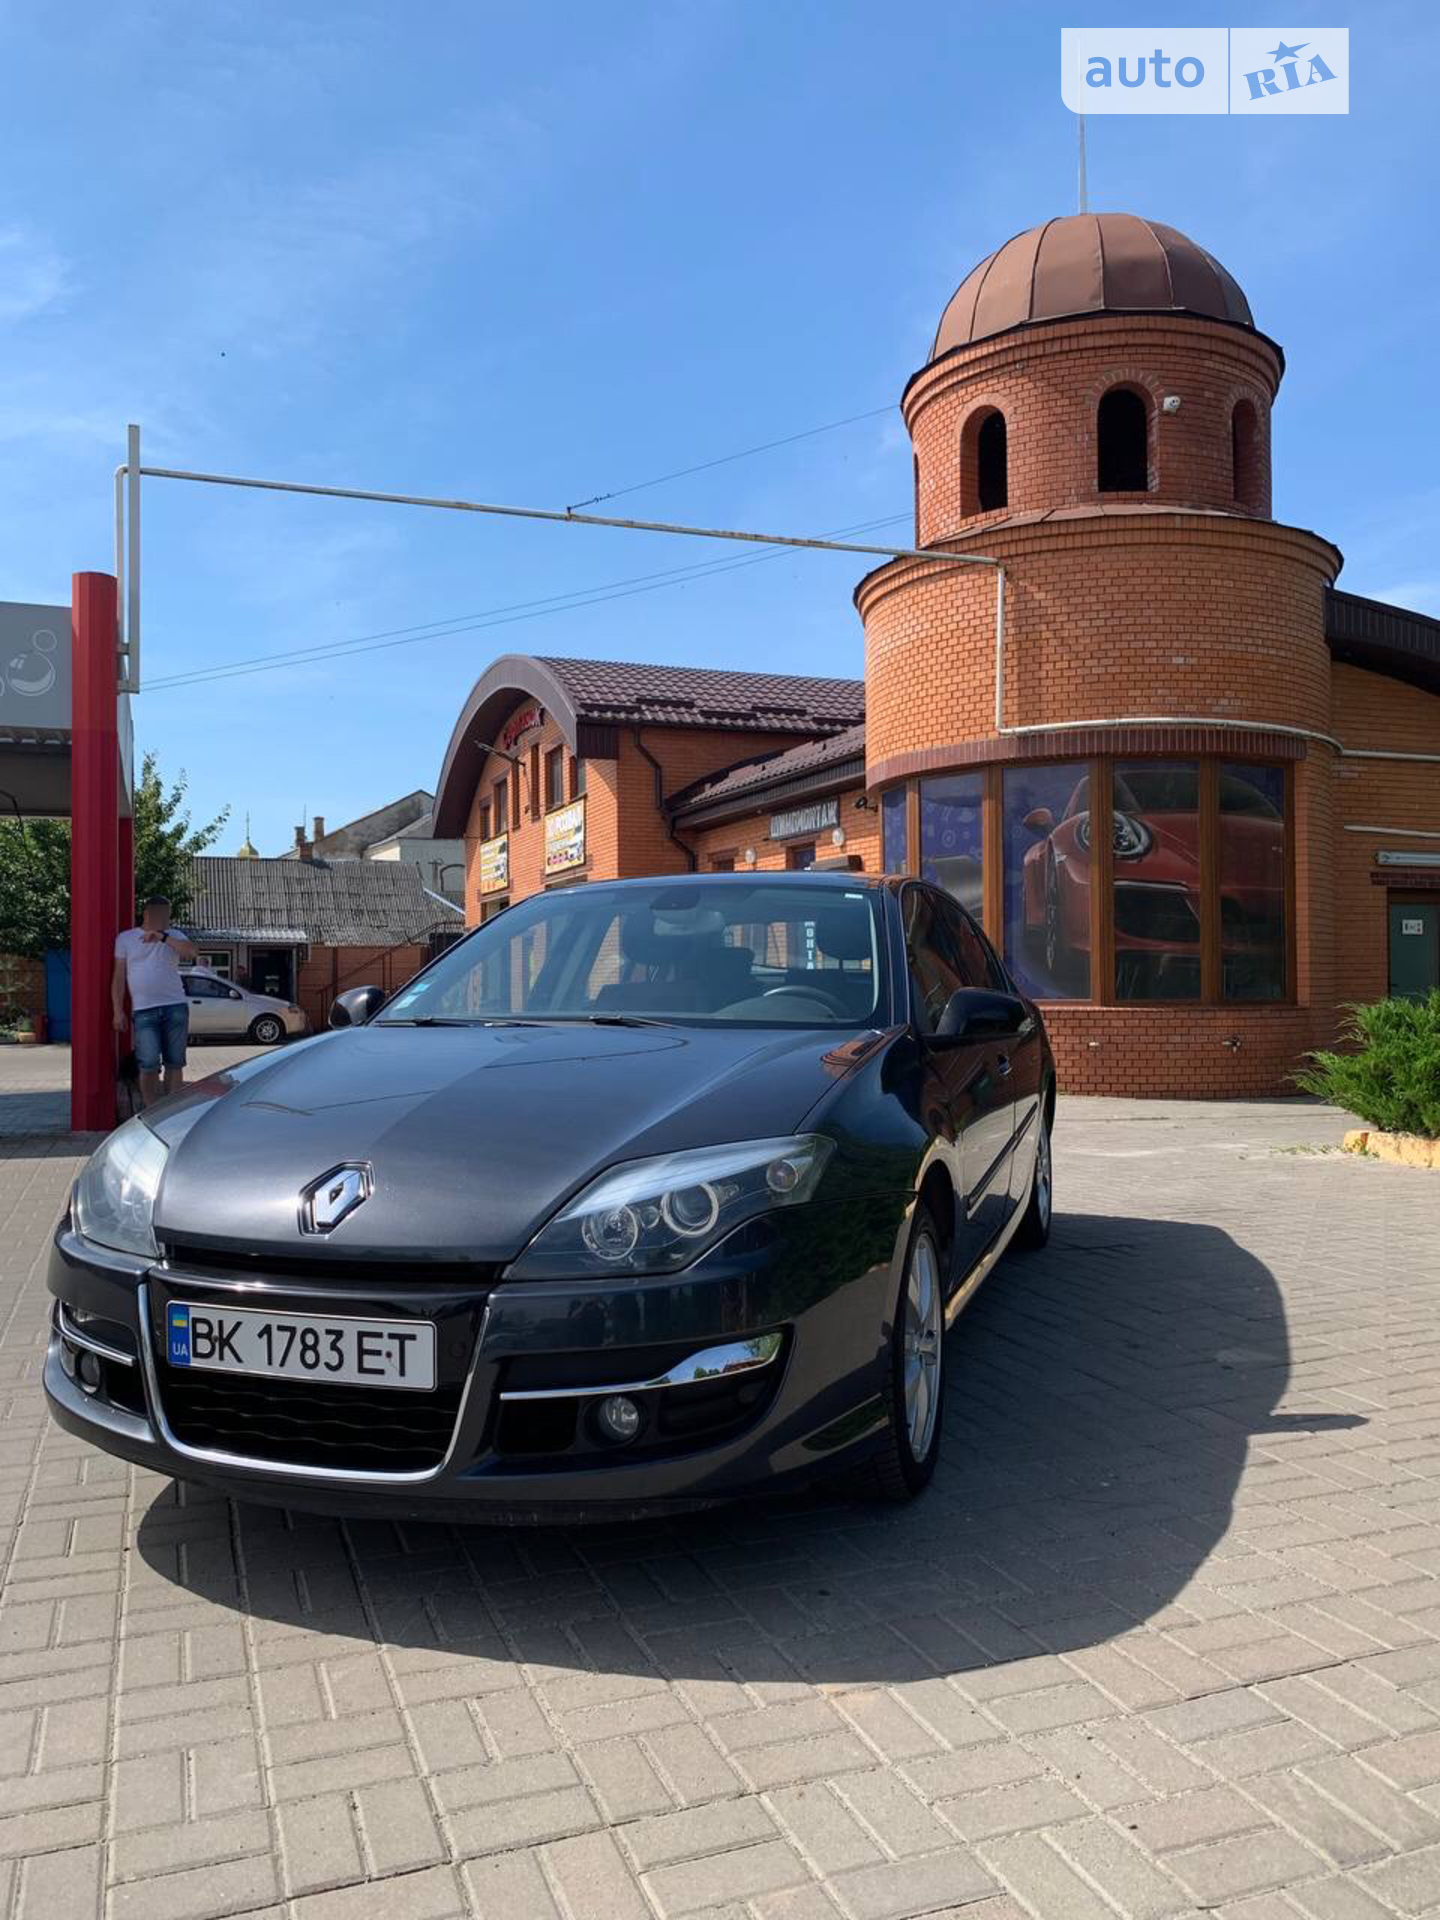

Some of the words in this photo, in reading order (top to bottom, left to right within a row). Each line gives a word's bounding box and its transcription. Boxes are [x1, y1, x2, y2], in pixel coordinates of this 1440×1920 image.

[172, 1342, 188, 1357] UA
[191, 1317, 244, 1364] BK
[257, 1323, 345, 1371] 1783
[356, 1330, 418, 1378] ET
